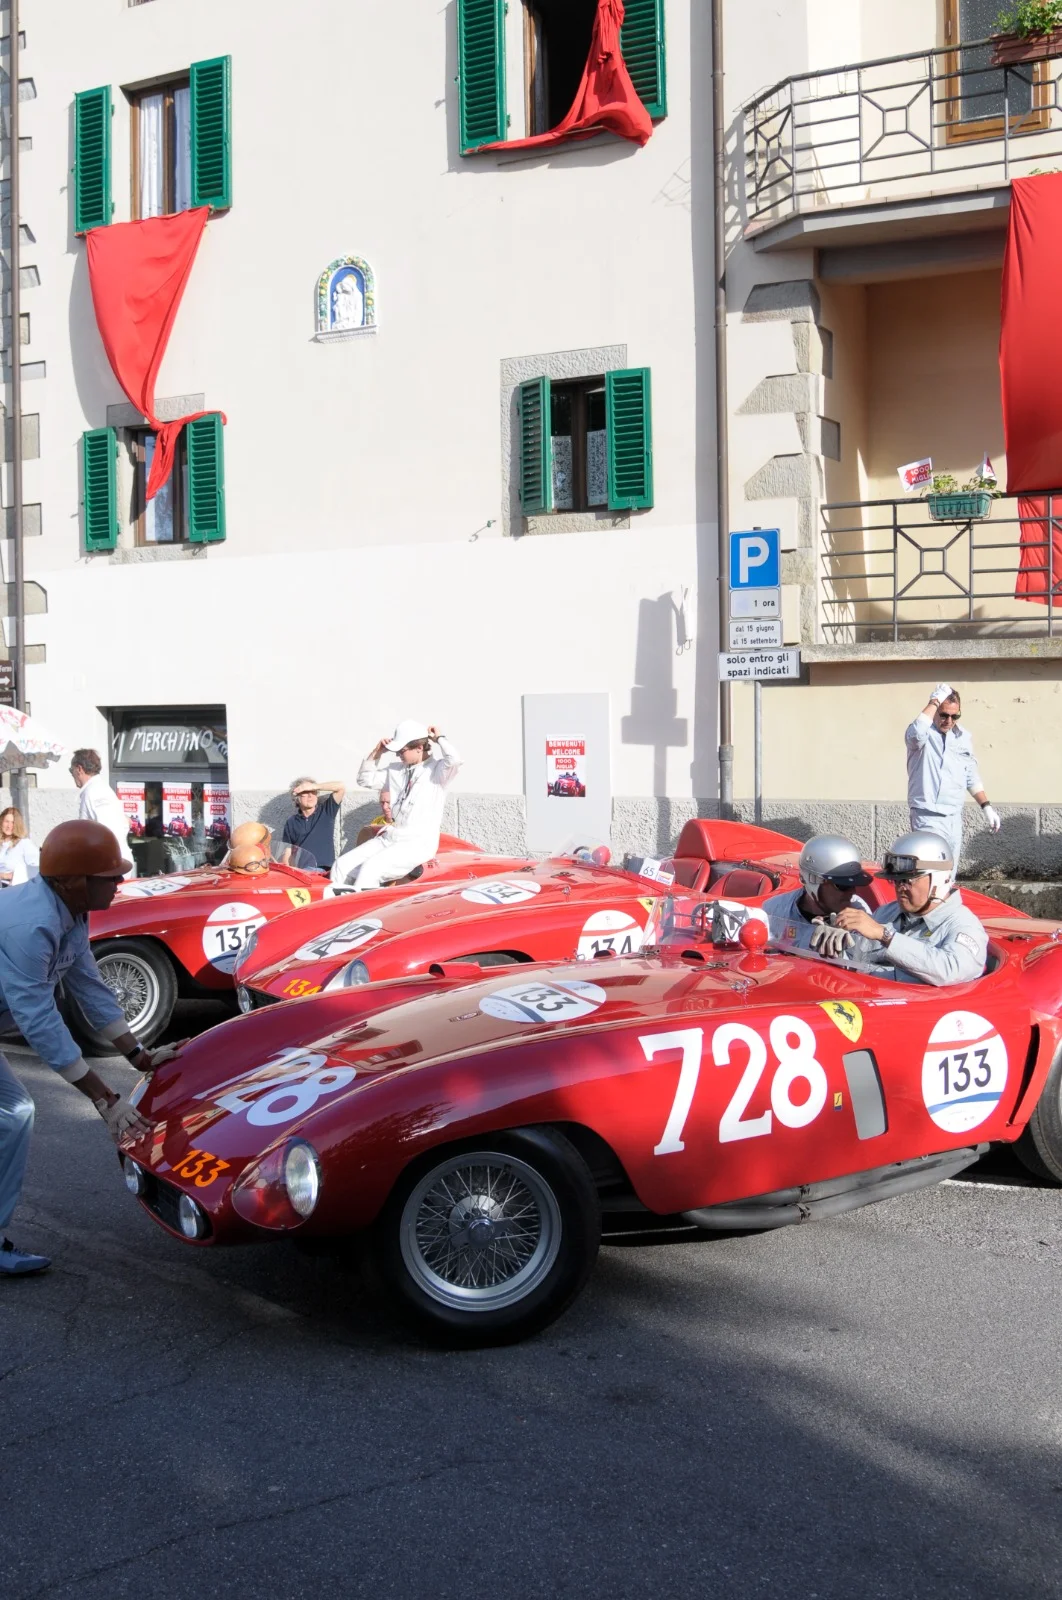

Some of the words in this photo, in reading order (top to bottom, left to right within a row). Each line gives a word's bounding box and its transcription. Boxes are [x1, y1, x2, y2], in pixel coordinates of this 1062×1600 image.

[739, 536, 769, 583] P
[754, 599, 758, 607] 1
[747, 624, 753, 632] 15
[756, 624, 775, 633] giugno
[741, 637, 747, 645] 15
[726, 655, 746, 664] solo
[749, 654, 774, 663] entro
[777, 652, 789, 663] gli
[727, 667, 751, 678] spazi
[754, 665, 789, 676] indicati
[548, 740, 585, 748] BENVENUTI
[643, 866, 655, 877] 65
[481, 884, 522, 898] 134
[511, 987, 579, 1012] 133
[938, 1048, 992, 1096] 133
[192, 1047, 357, 1126] 728
[638, 1014, 828, 1156] 728
[171, 1149, 231, 1188] 133
